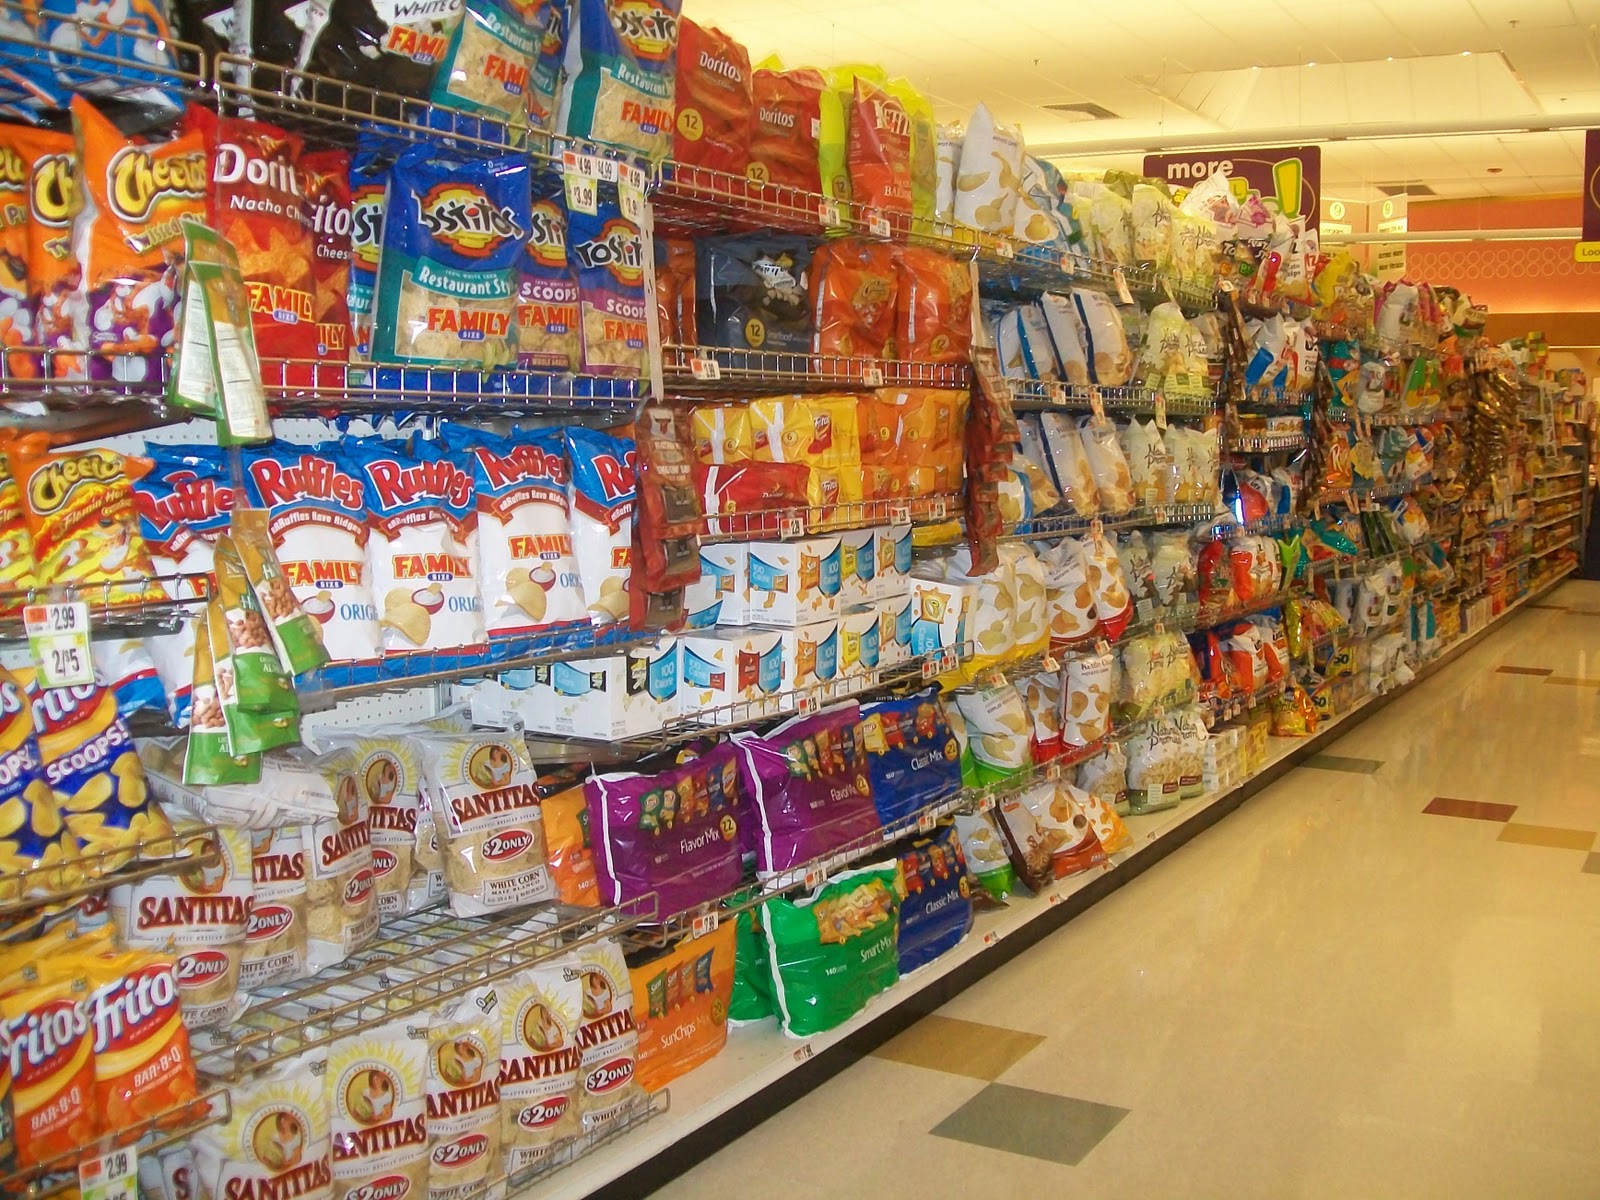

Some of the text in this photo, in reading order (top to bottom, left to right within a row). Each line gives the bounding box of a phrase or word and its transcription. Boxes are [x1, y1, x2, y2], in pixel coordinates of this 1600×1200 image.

[700, 51, 741, 83] Doritos
[618, 63, 667, 97] Restaurant
[621, 101, 675, 132] FAMILY
[684, 114, 698, 130] 12
[759, 107, 795, 128] Doritos
[1167, 160, 1234, 180] more
[574, 187, 593, 207] $3.99
[835, 181, 846, 193] 12
[230, 195, 282, 215] Nacho
[1334, 204, 1342, 216] 9
[1384, 203, 1391, 215] 9
[418, 266, 491, 295] Restaurant
[427, 307, 511, 336] FAMILY
[549, 325, 566, 333] SIZE
[750, 324, 761, 337] 12
[787, 433, 794, 442] 6
[882, 429, 888, 437] 6
[727, 441, 733, 450] 6
[475, 445, 566, 492] Ruffles
[253, 454, 364, 511] Ruffles
[369, 459, 475, 511] Ruffles
[311, 511, 332, 523] Have
[333, 514, 363, 535] Ridges
[509, 534, 572, 560] FAMILY
[283, 560, 364, 587] FAMILY
[393, 553, 471, 580] FAMILY
[432, 573, 449, 581] SIZE
[828, 561, 839, 573] 100
[320, 580, 340, 588] SIZE
[51, 606, 76, 632] $2.99
[52, 649, 81, 677] 2/$5
[661, 662, 675, 675] 100
[47, 719, 129, 785] SCOOPS!
[929, 751, 943, 763] Mix
[451, 780, 541, 827] SANTITAS
[830, 785, 851, 802] Flavor
[722, 819, 733, 832] 22
[483, 835, 531, 856] $2 ONLY
[681, 828, 720, 855] Flavor Mix
[490, 871, 541, 890] WHITE CORN
[577, 882, 589, 891] 140
[137, 895, 255, 931] SANTITAS
[926, 891, 959, 915] Classic Mix
[260, 912, 289, 929] ONLY
[860, 937, 893, 961] Smart Mix
[195, 959, 227, 975] ONLY
[241, 961, 266, 974] HITE
[268, 953, 295, 969] CORN
[825, 966, 837, 976] 140
[661, 1020, 696, 1049] SunChips
[587, 1061, 634, 1092] $2 ONLY
[520, 1106, 546, 1125] $2
[433, 1139, 486, 1164] $2 ONLY
[224, 1152, 332, 1200] SANTITAS
[374, 1179, 408, 1198] ONLY
